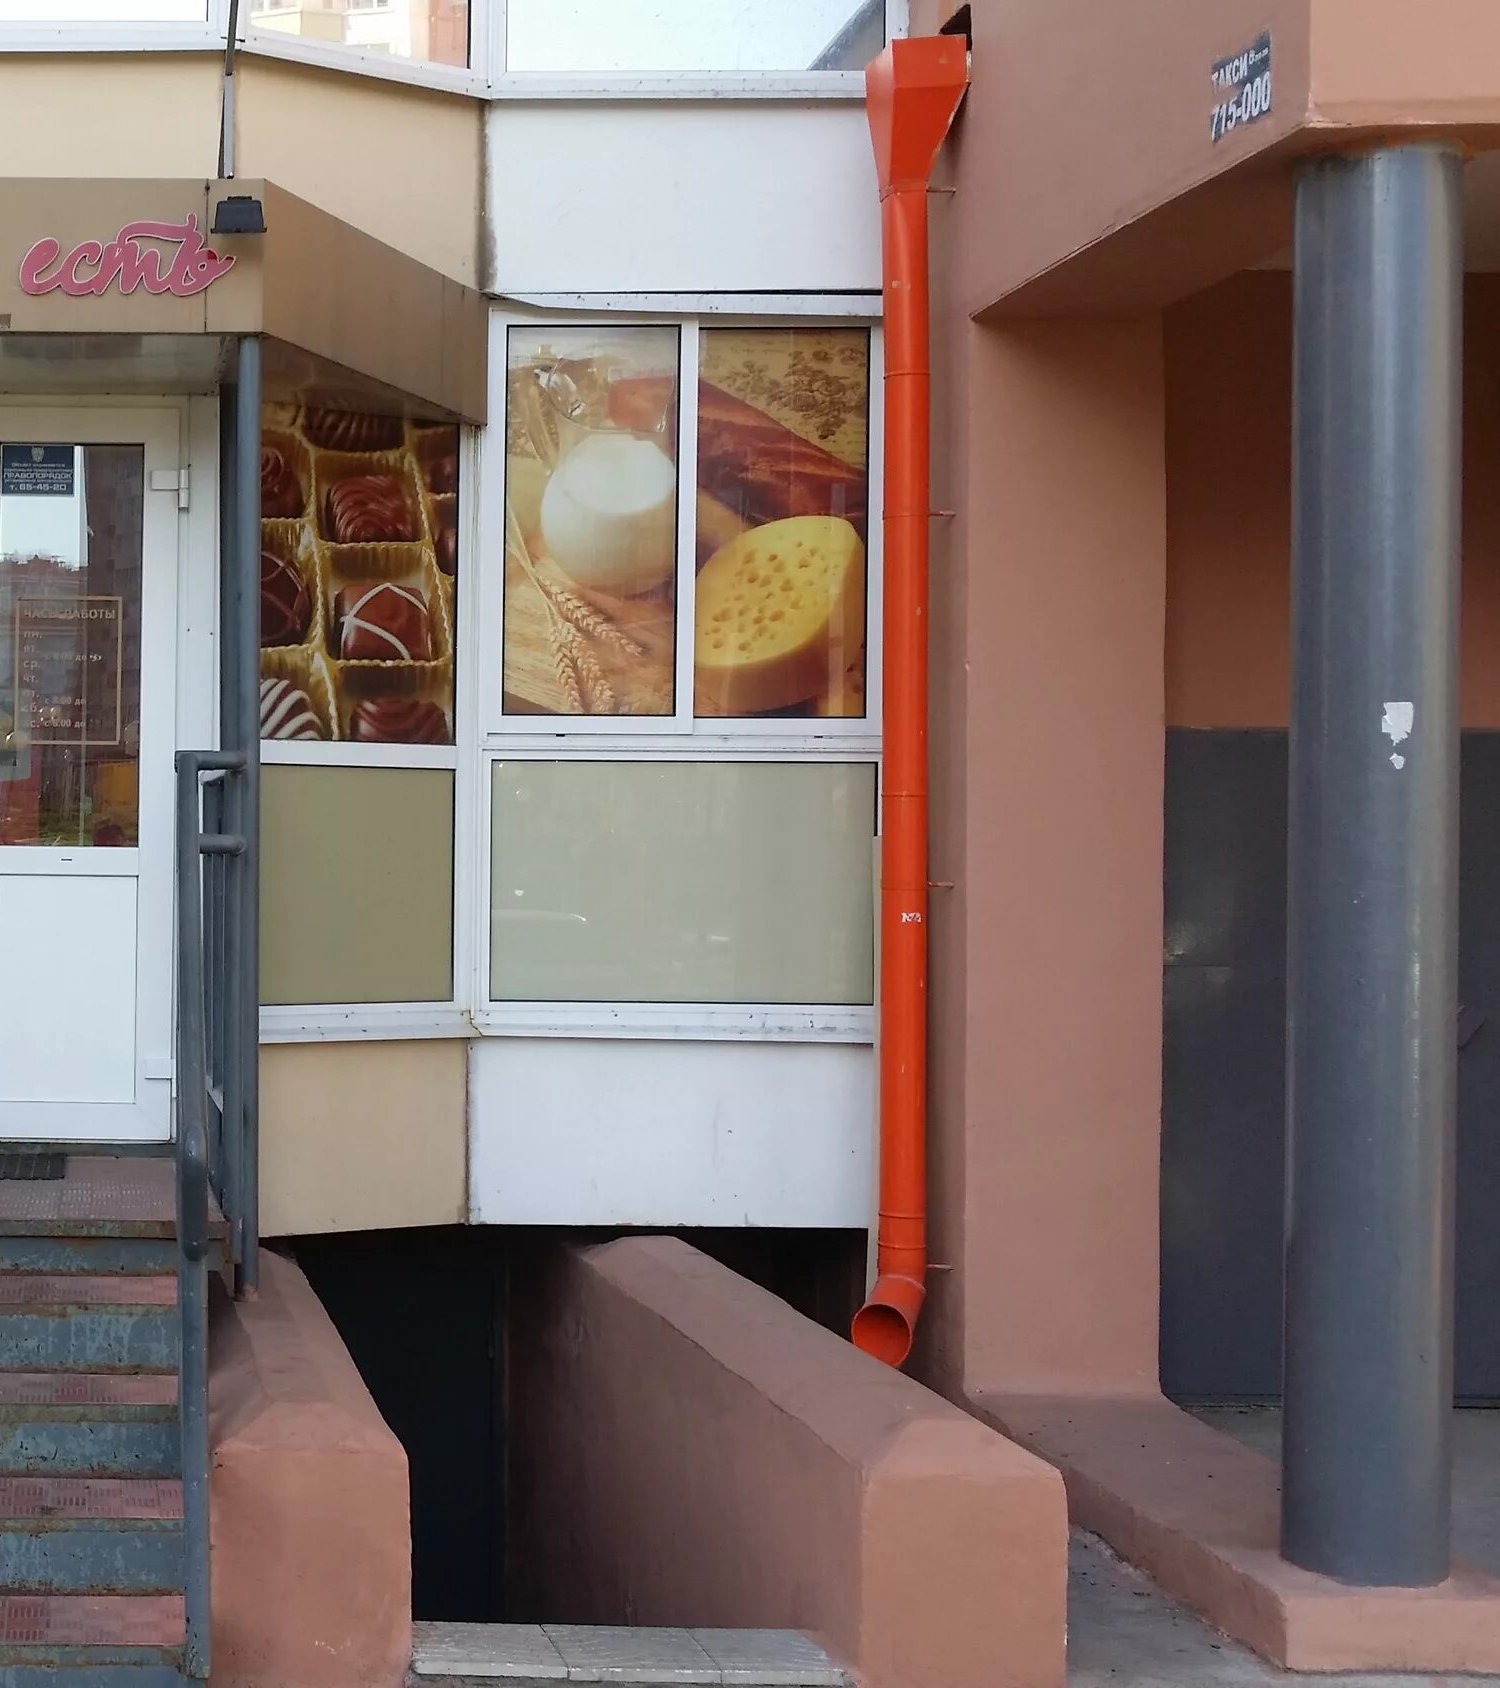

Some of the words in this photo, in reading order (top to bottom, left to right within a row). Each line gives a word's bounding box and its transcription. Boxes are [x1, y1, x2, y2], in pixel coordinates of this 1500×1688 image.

[1211, 53, 1248, 91] ТАКСИ
[1211, 71, 1271, 141] 715-000
[20, 212, 237, 297] есть
